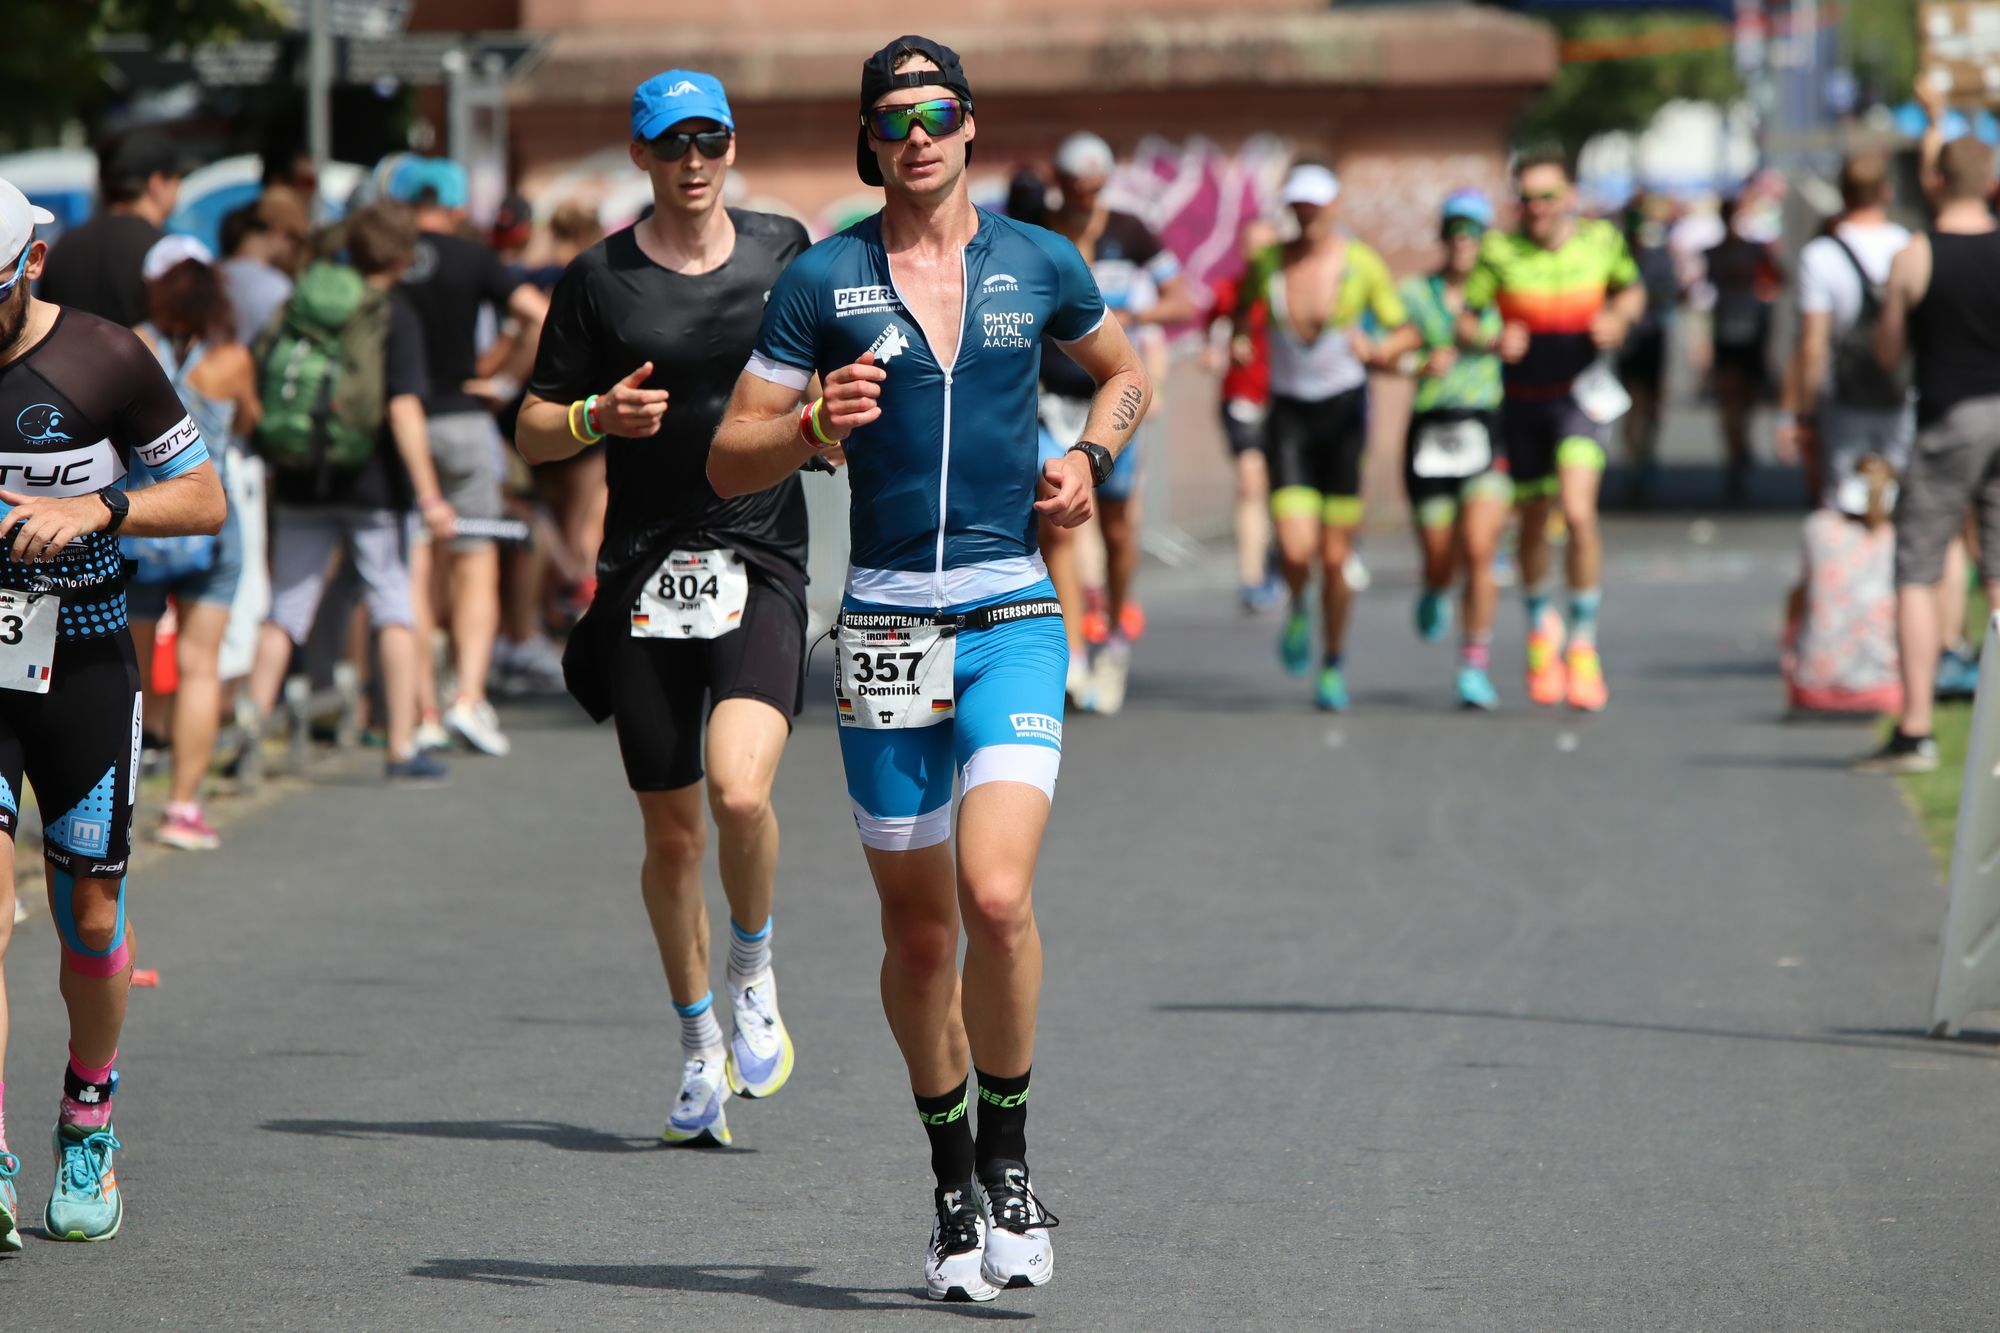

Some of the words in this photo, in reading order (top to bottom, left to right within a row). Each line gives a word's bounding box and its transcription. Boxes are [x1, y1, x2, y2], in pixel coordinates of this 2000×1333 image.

[982, 283, 1019, 294] skinfit
[838, 288, 898, 305] PETERS
[983, 312, 1034, 325] PHYSIO
[983, 324, 1022, 337] VITAL
[983, 337, 1032, 348] AACHEN
[140, 419, 196, 461] TRITYC
[658, 574, 719, 600] 804
[677, 602, 701, 611] Jan
[845, 614, 936, 628] ETERSSPORTTEAM.DE
[866, 630, 911, 641] IRONMAN
[852, 652, 923, 683] 357
[858, 684, 921, 697] Dominik
[47, 850, 71, 865] poli
[91, 860, 126, 873] poli
